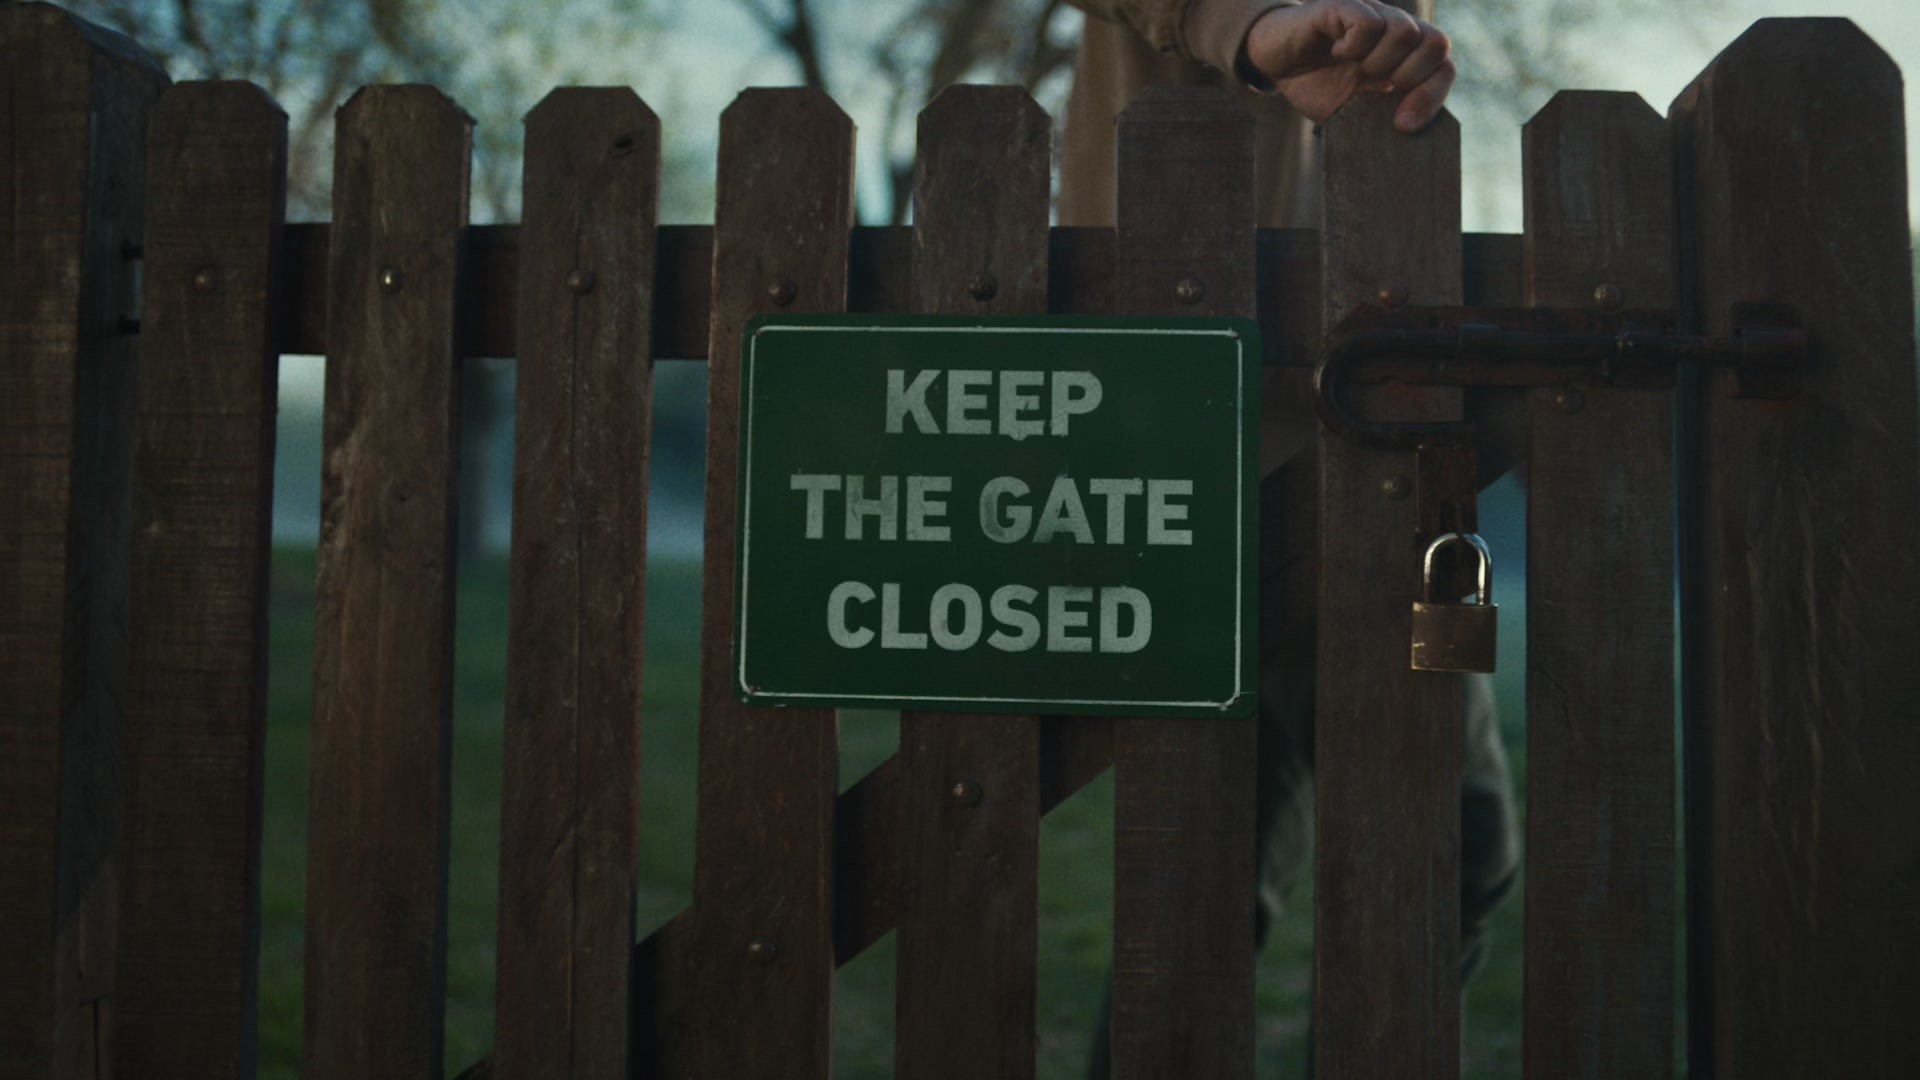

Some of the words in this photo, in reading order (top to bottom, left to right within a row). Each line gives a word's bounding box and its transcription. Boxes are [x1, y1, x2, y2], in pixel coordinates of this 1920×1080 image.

[886, 369, 1103, 441] KEEP
[790, 474, 952, 542] THE
[980, 476, 1194, 546] GATE
[827, 581, 1153, 653] CLOSED
